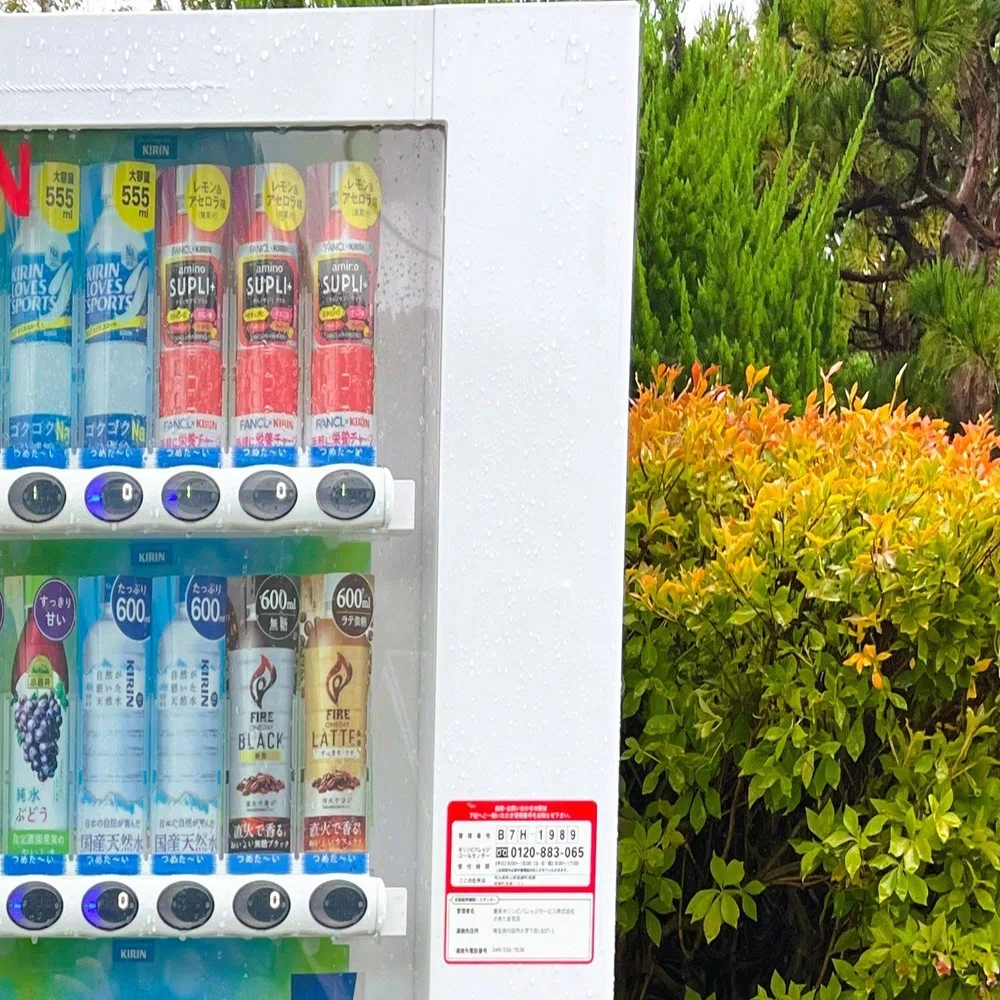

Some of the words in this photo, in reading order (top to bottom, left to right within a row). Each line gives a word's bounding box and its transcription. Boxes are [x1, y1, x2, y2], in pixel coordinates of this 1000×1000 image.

[142, 145, 170, 156] KIRIN
[129, 170, 150, 183] 大容量
[46, 186, 74, 209] 555
[122, 185, 149, 207] 555
[11, 264, 44, 282] KIRIN
[86, 263, 120, 282] KIRIN
[178, 265, 206, 275] amino
[256, 264, 283, 274] amino
[11, 279, 47, 297] LOVES
[86, 279, 123, 297] LOVES
[11, 295, 57, 315] SPORTS
[86, 295, 133, 314] SPORTS
[138, 552, 166, 563] KIRIN
[117, 583, 148, 597] たっぷり
[192, 583, 223, 597] たっぷり
[39, 595, 71, 609] すっきり
[115, 598, 145, 623] 600
[190, 598, 220, 623] 600
[45, 612, 67, 627] 甘い
[125, 660, 135, 708] KIRIN
[200, 660, 210, 708] KIRIN
[250, 711, 274, 723] FIRE
[326, 709, 350, 722] FIRE
[238, 732, 284, 750] BLACK
[16, 787, 40, 801] 純水
[15, 805, 49, 822] ぶどう
[80, 833, 144, 852] 国産天然水
[511, 846, 584, 858] 0120-883-065
[119, 949, 147, 960] KIRIN
